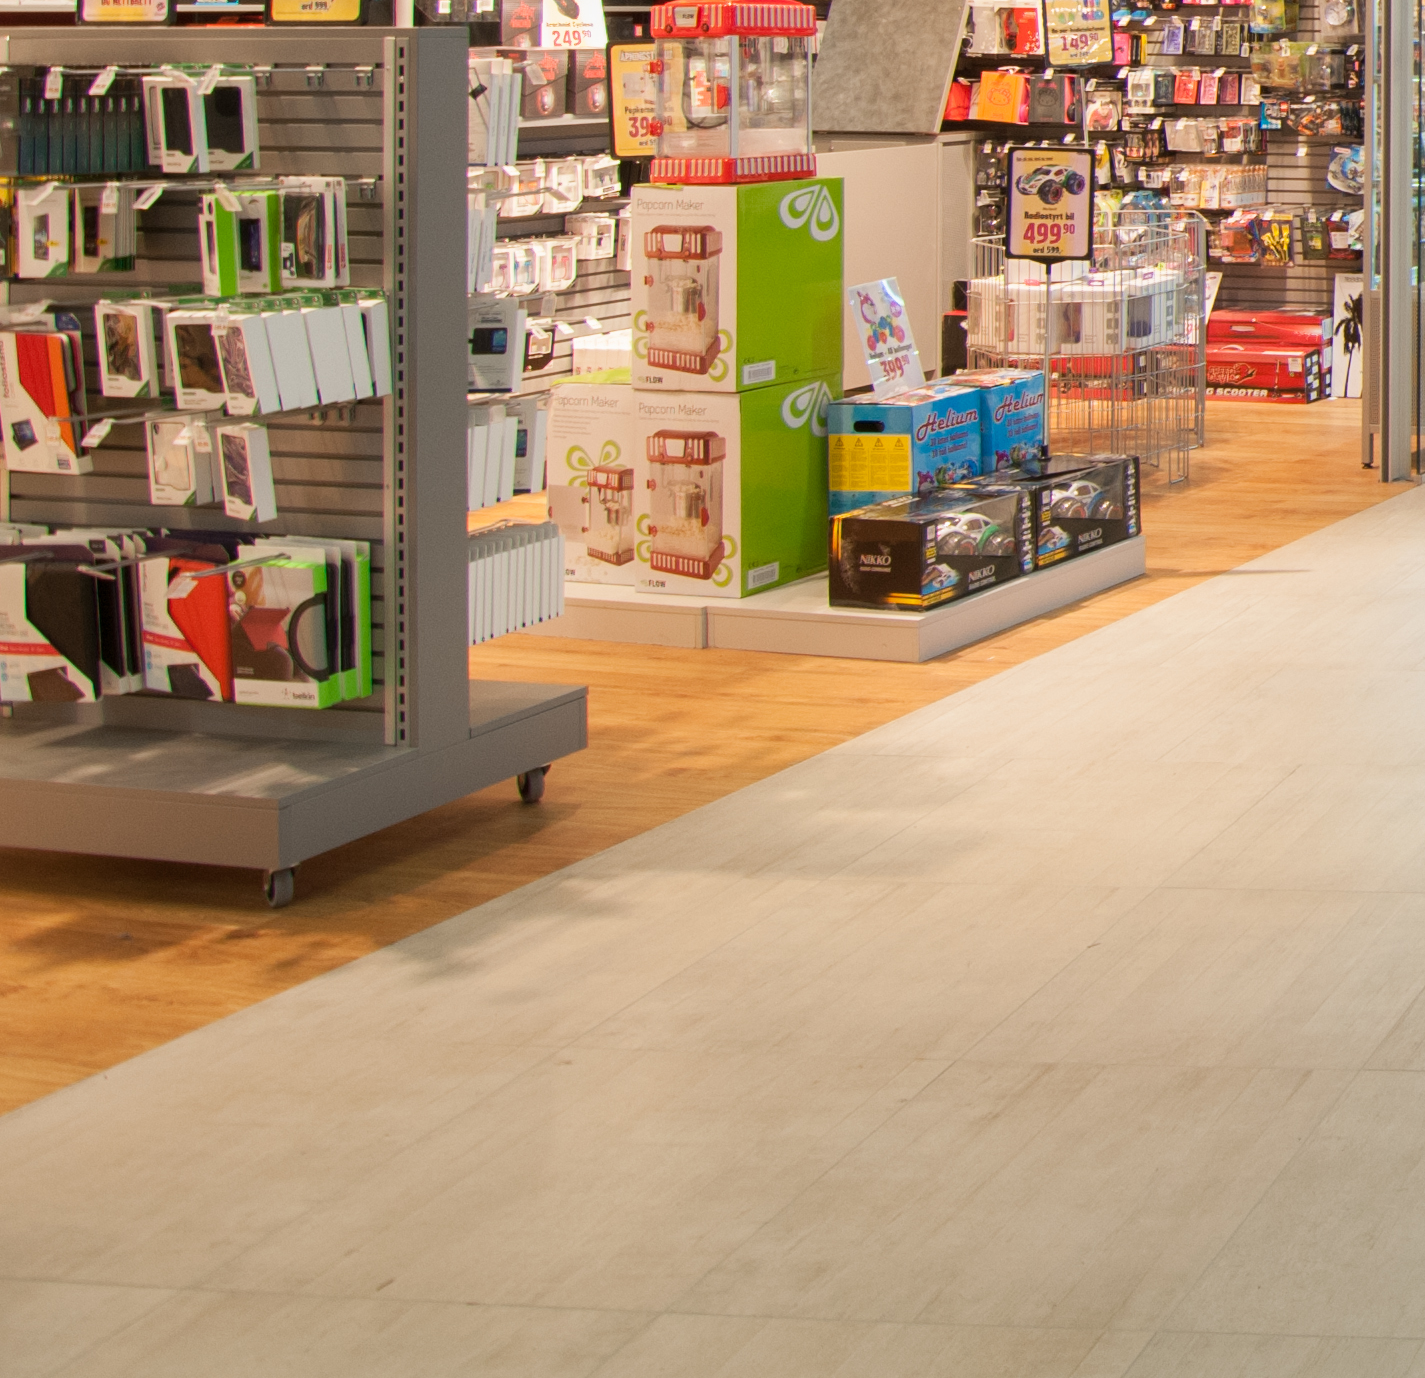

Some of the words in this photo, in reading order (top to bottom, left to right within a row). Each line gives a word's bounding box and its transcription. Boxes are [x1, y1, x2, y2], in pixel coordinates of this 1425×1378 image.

[552, 30, 582, 47] 249
[637, 198, 672, 212] Popcorn
[675, 199, 704, 211] Maker
[1024, 211, 1063, 222] Radiostyrt
[1065, 212, 1075, 221] bil
[1215, 388, 1269, 397] SCOOTER
[591, 395, 619, 408] Maker
[994, 392, 1044, 423] Helium
[638, 402, 676, 416] Popcorn
[678, 404, 707, 416] Maker
[916, 408, 978, 442] Helium
[1078, 527, 1102, 544] NIKKO
[860, 554, 891, 566] NIKKO
[968, 565, 995, 583] NIKKO
[292, 692, 315, 700] belkin
